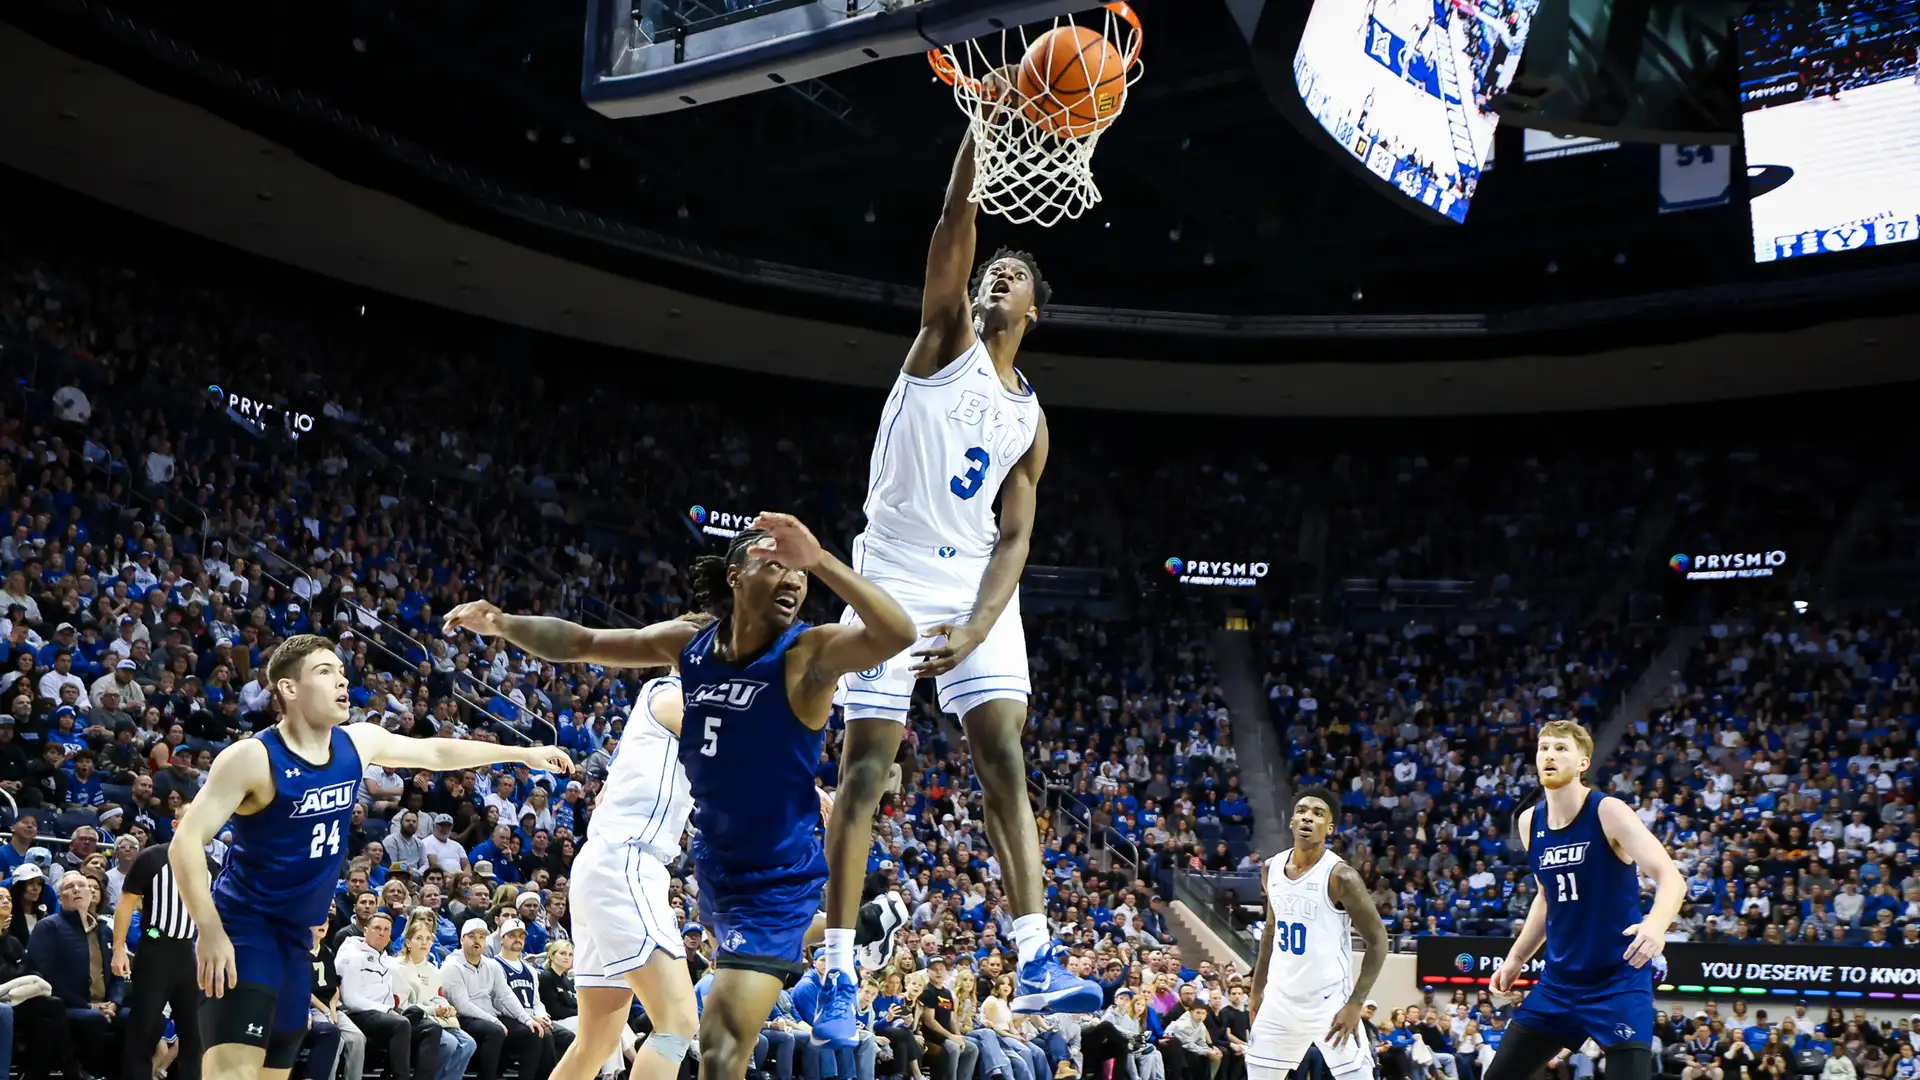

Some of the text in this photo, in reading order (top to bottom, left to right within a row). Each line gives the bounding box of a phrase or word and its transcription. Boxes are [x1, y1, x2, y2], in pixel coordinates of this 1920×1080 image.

[1885, 221, 1909, 240] 37
[949, 446, 991, 501] 3
[710, 510, 754, 531] PRYS
[1187, 560, 1247, 576] PRYSM
[1694, 553, 1761, 570] PRYSM
[700, 716, 722, 757] 5
[298, 785, 352, 815] ACU
[309, 819, 341, 858] 24
[1542, 846, 1584, 867] ACU
[1556, 872, 1579, 902] 21
[1277, 920, 1307, 955] 30
[312, 961, 328, 987] 7
[1701, 962, 1742, 979] YOU
[1745, 963, 1834, 982] DESERVE
[1838, 966, 1867, 983] TO
[521, 988, 532, 1008] 1
